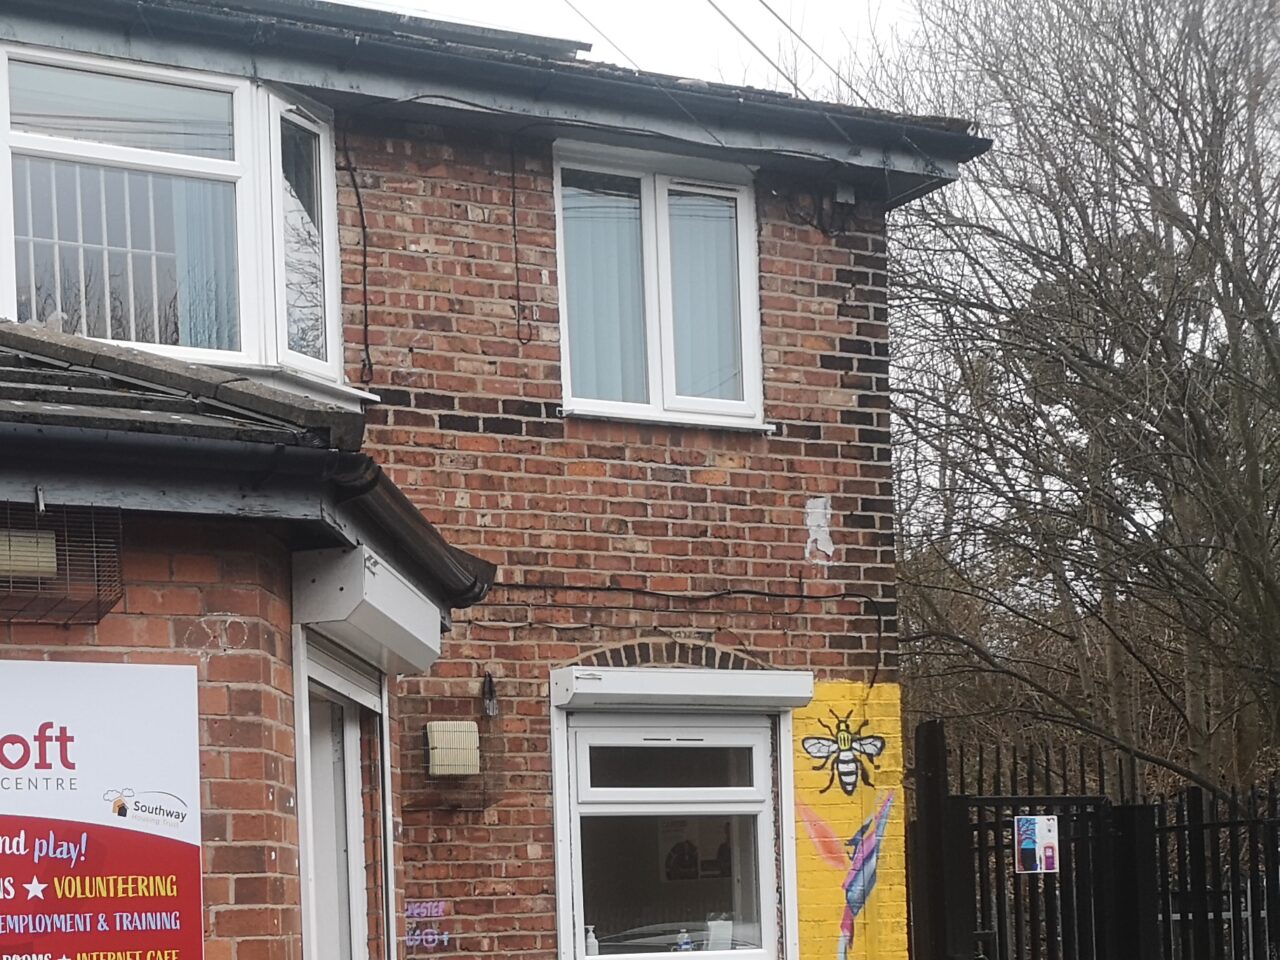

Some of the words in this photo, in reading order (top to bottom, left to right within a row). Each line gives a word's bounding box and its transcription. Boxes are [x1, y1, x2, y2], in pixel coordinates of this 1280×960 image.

[0, 777, 79, 791] CENTRE
[133, 800, 188, 823] Southway
[33, 830, 88, 869] play!
[53, 874, 178, 899] VOLUNTEERING
[97, 913, 110, 932] &
[113, 911, 181, 931] TRAINING
